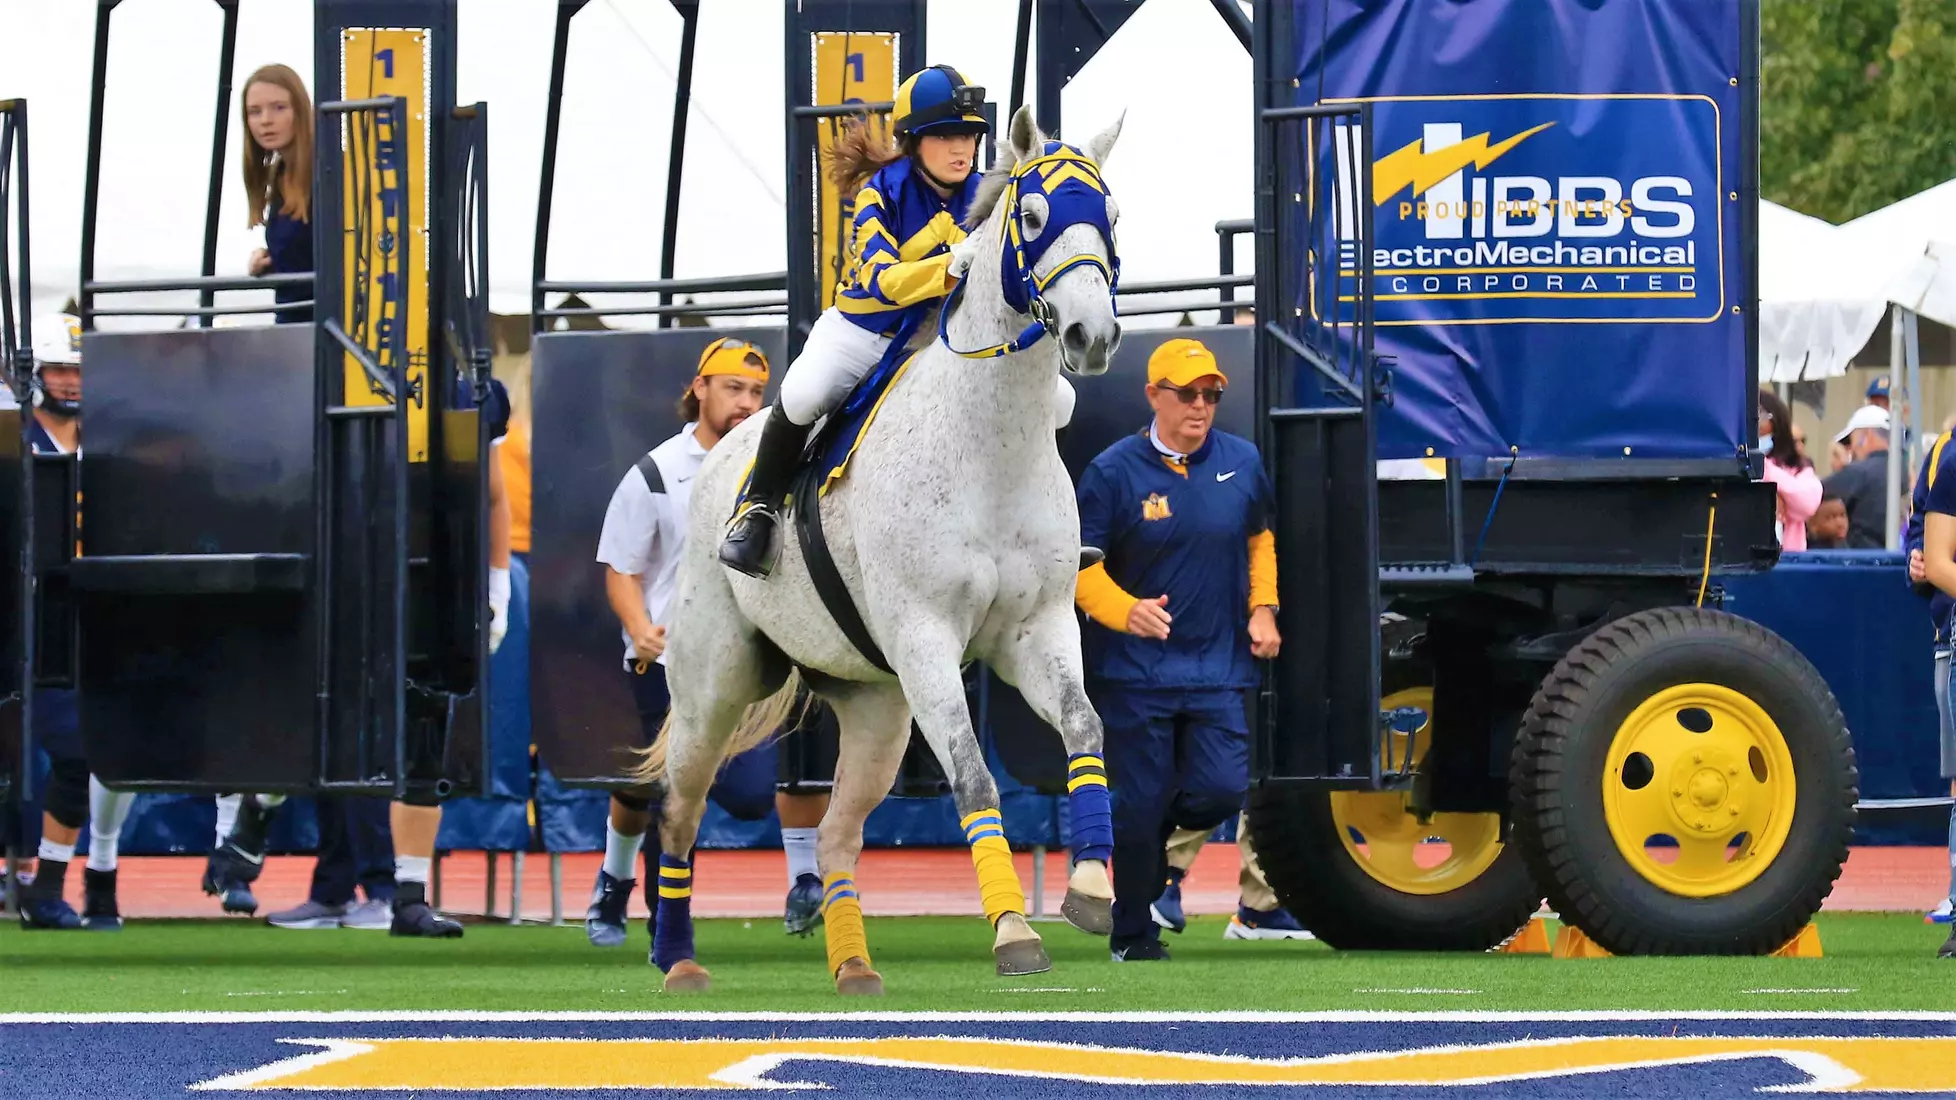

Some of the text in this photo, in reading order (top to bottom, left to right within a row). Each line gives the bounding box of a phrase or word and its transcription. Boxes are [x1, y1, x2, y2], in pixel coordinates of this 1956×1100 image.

[1399, 200, 1633, 220] PROUD PARTNERS
[1359, 274, 1696, 294] CORPORATED
